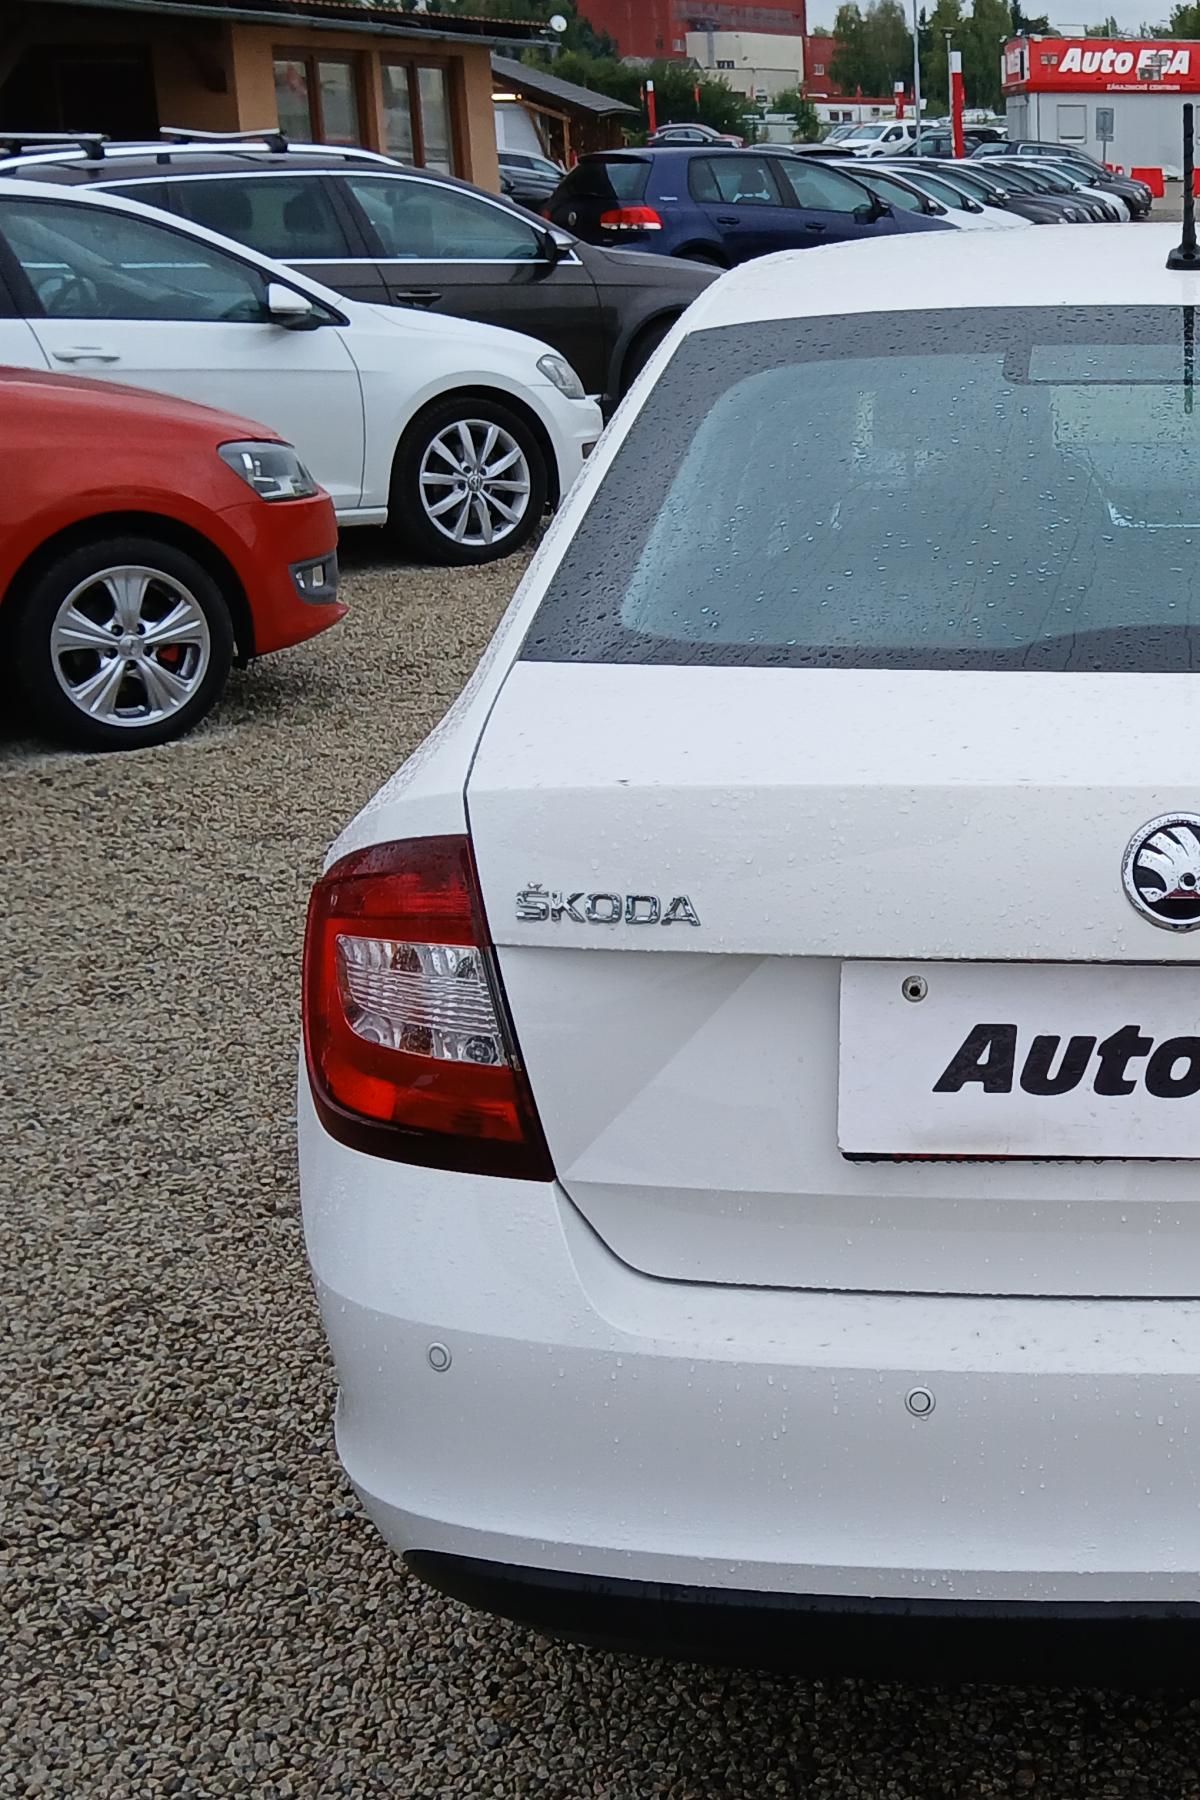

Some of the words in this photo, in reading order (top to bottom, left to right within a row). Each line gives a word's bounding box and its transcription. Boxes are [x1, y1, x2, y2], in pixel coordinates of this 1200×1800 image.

[1058, 48, 1134, 74] Auto
[1135, 50, 1190, 75] ESA
[515, 881, 701, 927] ŠKODA
